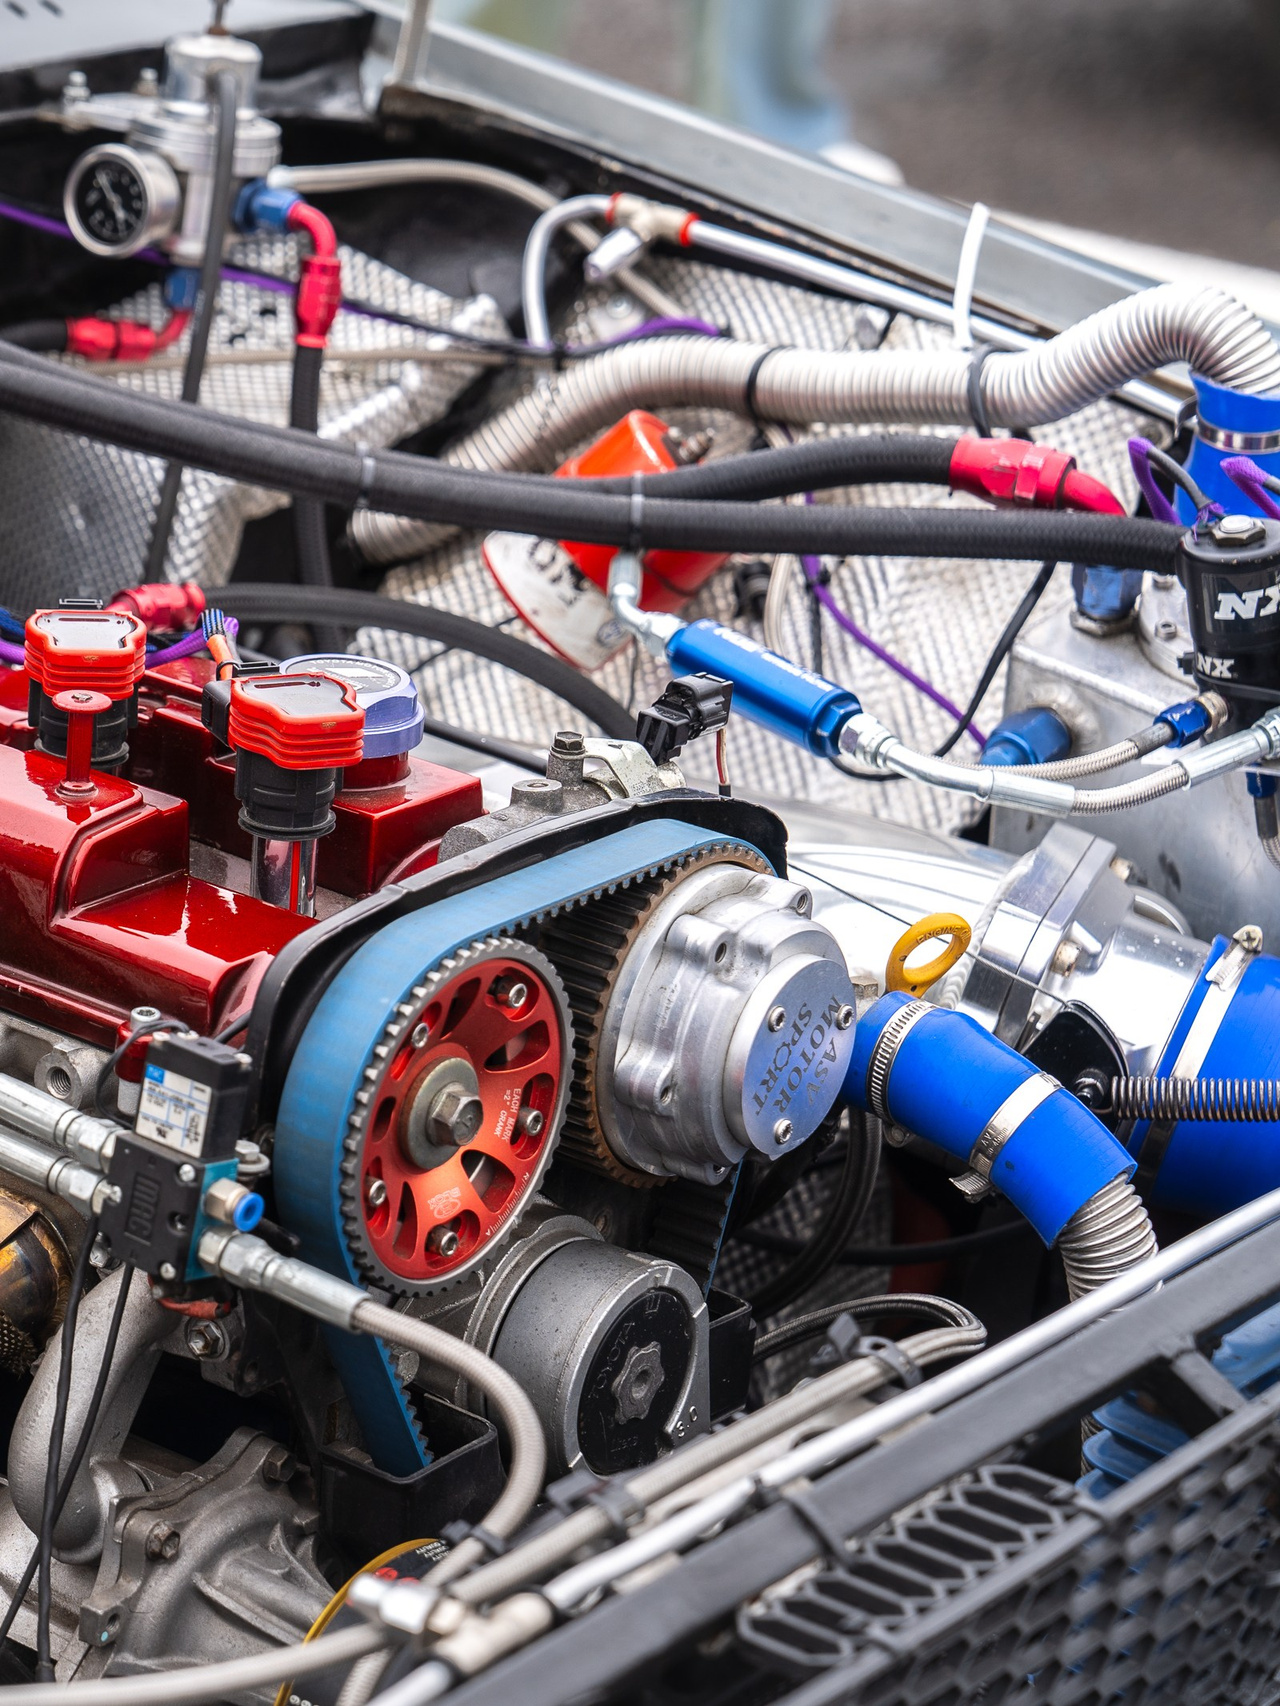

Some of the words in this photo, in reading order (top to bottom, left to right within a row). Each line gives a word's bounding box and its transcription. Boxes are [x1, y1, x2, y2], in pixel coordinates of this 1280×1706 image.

[1196, 652, 1235, 678] NX
[917, 925, 962, 945] ENGINE
[752, 1002, 813, 1116] SPORT
[773, 995, 843, 1113] MOTOR
[805, 1036, 838, 1107] ASV
[511, 1088, 522, 1115] EACH
[493, 1109, 508, 1139] CRANK
[501, 1114, 517, 1141] MARK
[588, 1322, 636, 1400] TOYOTA
